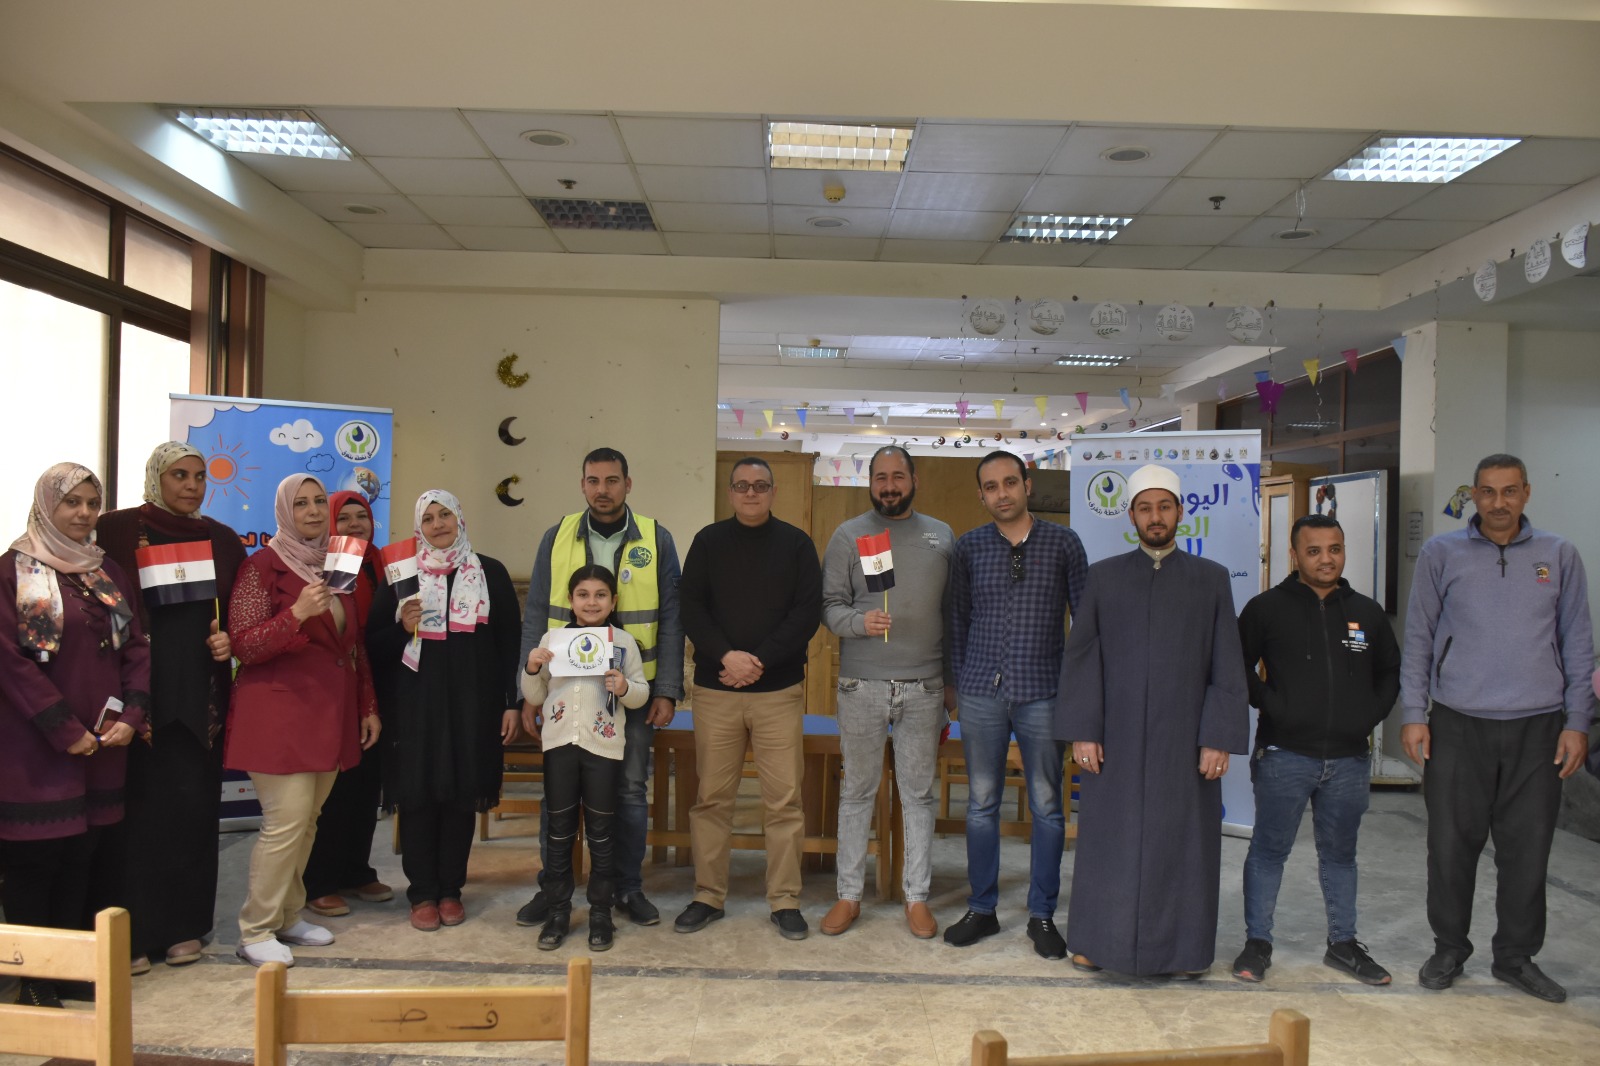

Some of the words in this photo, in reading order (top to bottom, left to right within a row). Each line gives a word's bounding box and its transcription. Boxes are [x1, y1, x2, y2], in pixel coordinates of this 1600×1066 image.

[1090, 310, 1128, 328] الطفل
[1180, 484, 1229, 516] اليو
[1104, 508, 1120, 516] نقطة
[1230, 571, 1248, 579] ضمن
